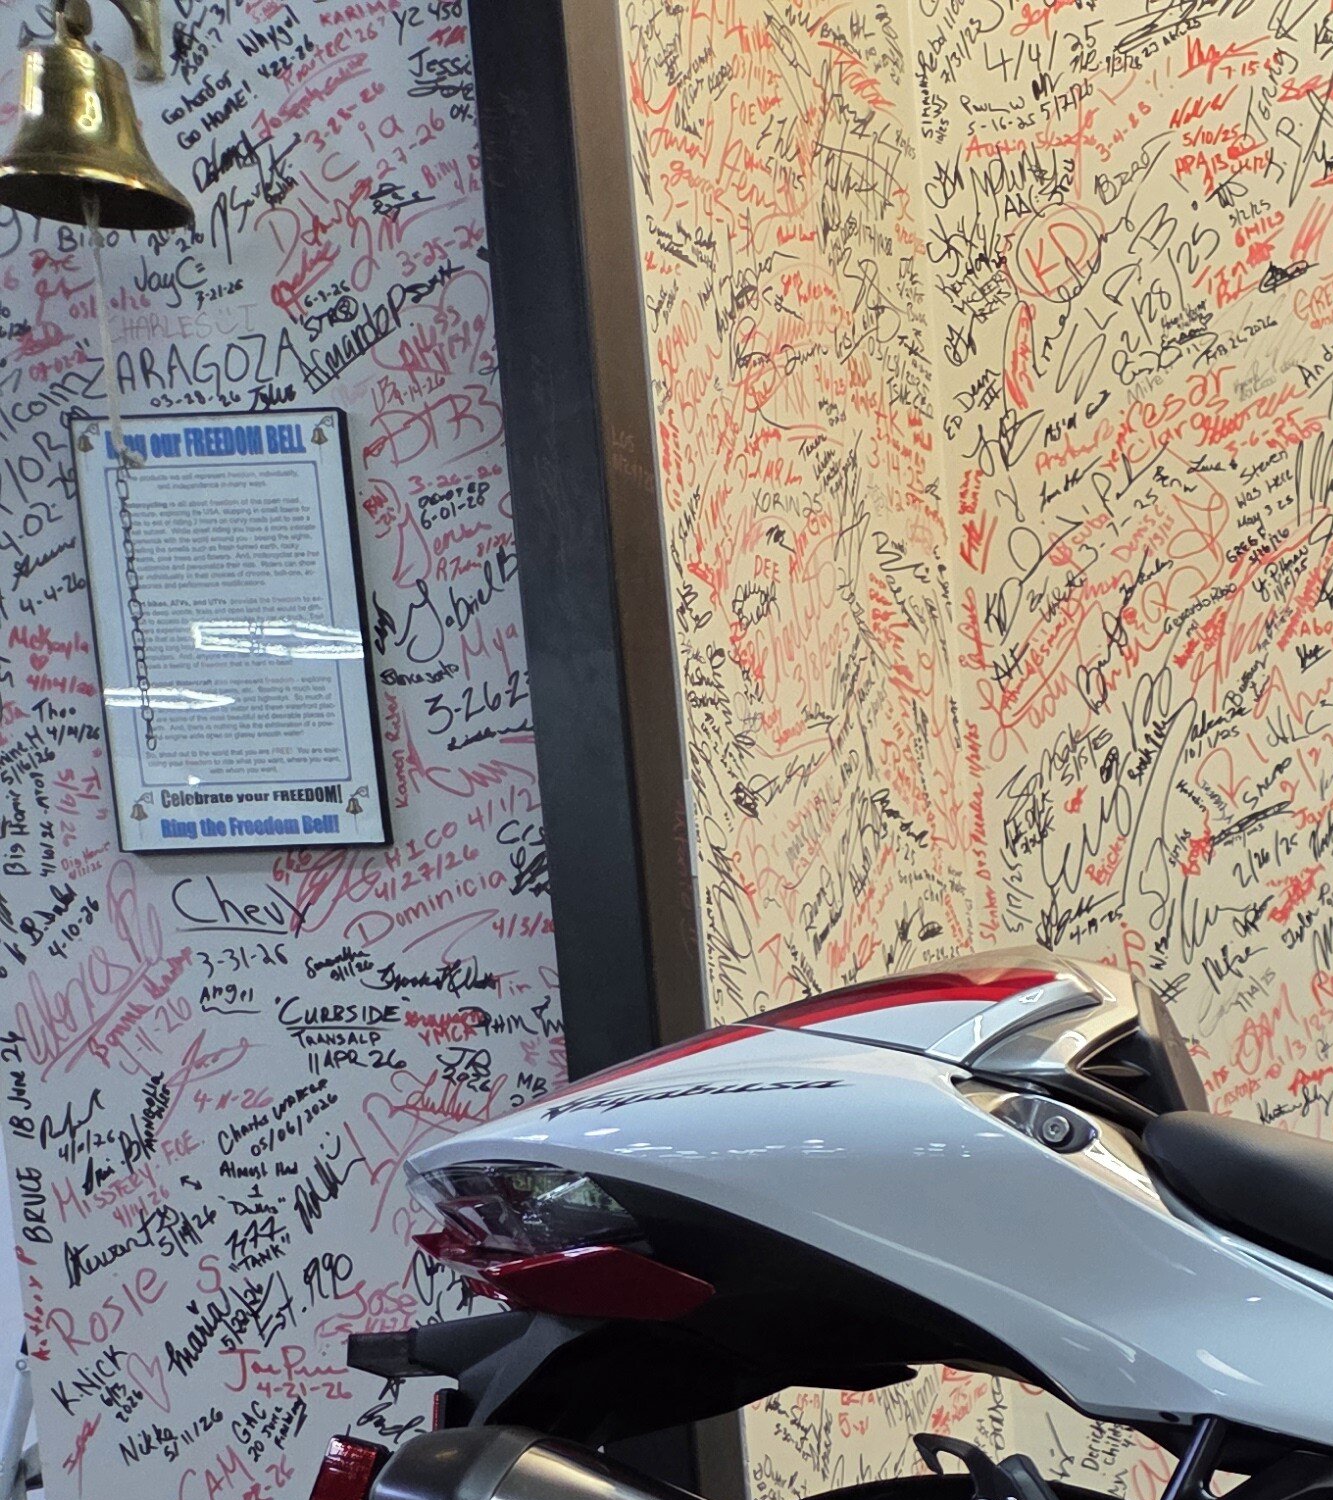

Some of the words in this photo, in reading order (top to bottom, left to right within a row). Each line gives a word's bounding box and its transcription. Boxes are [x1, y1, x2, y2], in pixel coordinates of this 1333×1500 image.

[150, 432, 181, 458] our
[183, 425, 263, 457] FREEDOM
[265, 424, 307, 454] BELL
[161, 789, 233, 808] Celebrate
[236, 792, 270, 805] your
[272, 784, 344, 804] FREEDOM!
[160, 818, 198, 839] Ring
[199, 818, 227, 837] the
[229, 816, 300, 837] Freedom
[198, 942, 288, 978] 3-31-26
[322, 1049, 365, 1071] APR
